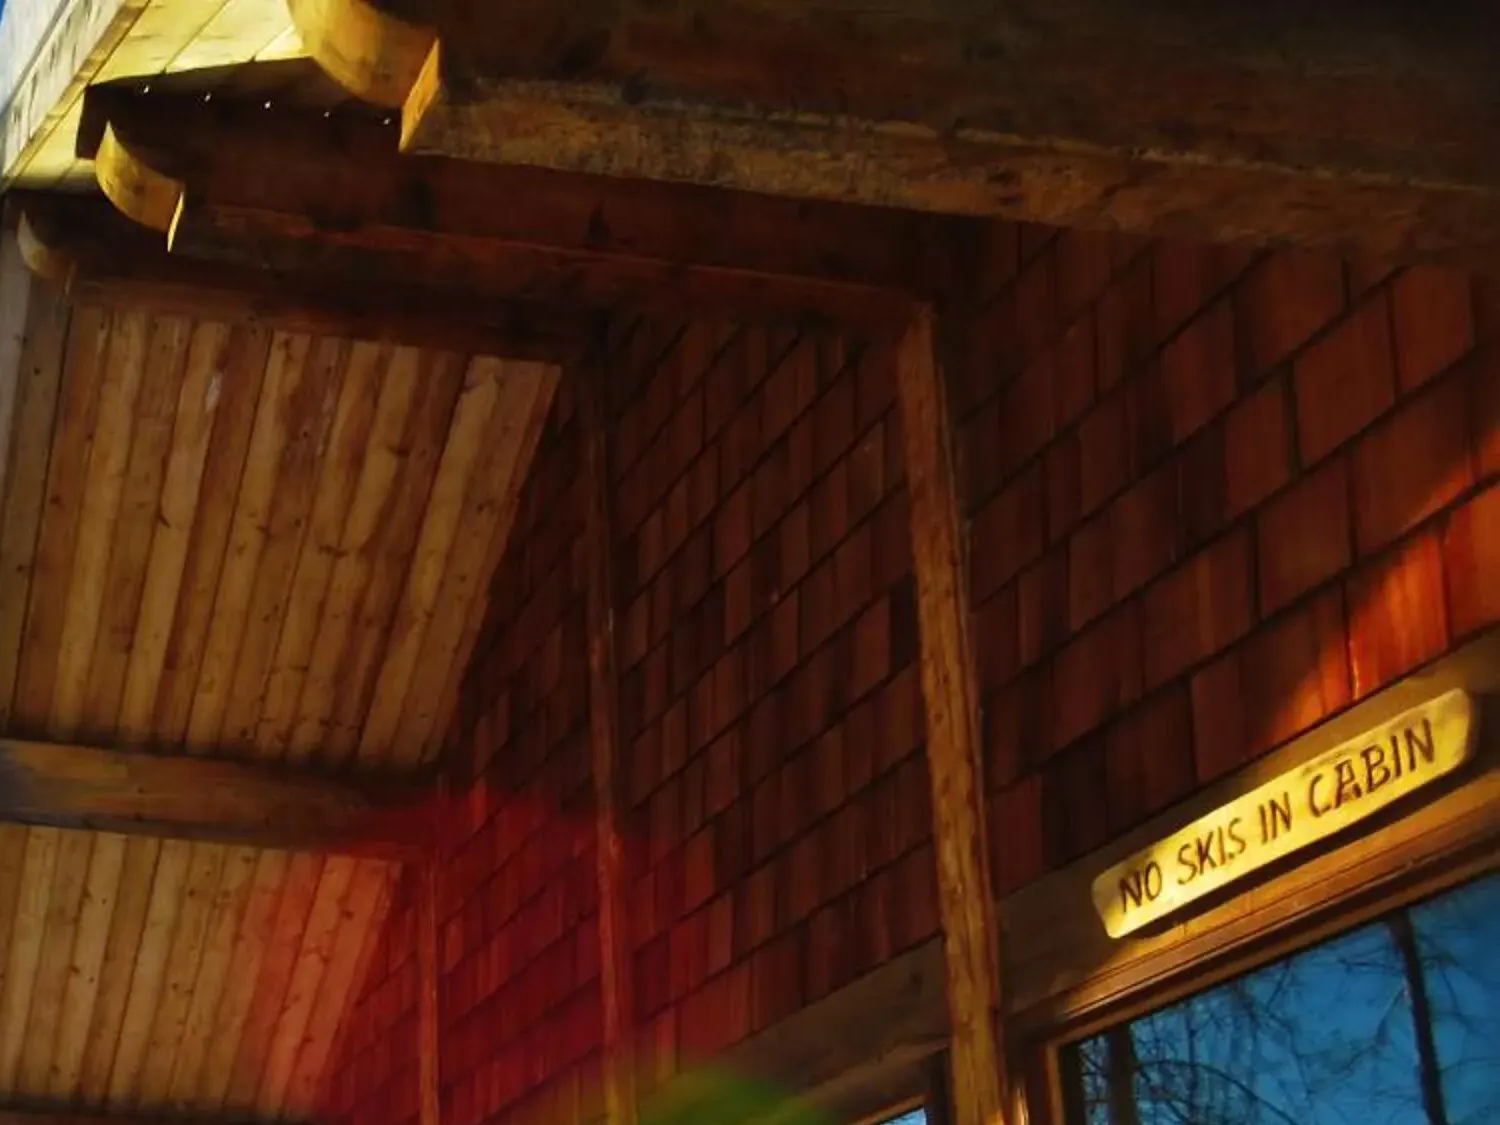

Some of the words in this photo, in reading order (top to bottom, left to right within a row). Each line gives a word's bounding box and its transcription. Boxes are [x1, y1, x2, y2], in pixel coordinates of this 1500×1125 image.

[1117, 861, 1163, 913] NO
[1177, 816, 1246, 886] SKIS
[1257, 792, 1293, 844] IN
[1308, 718, 1435, 818] CABIN
